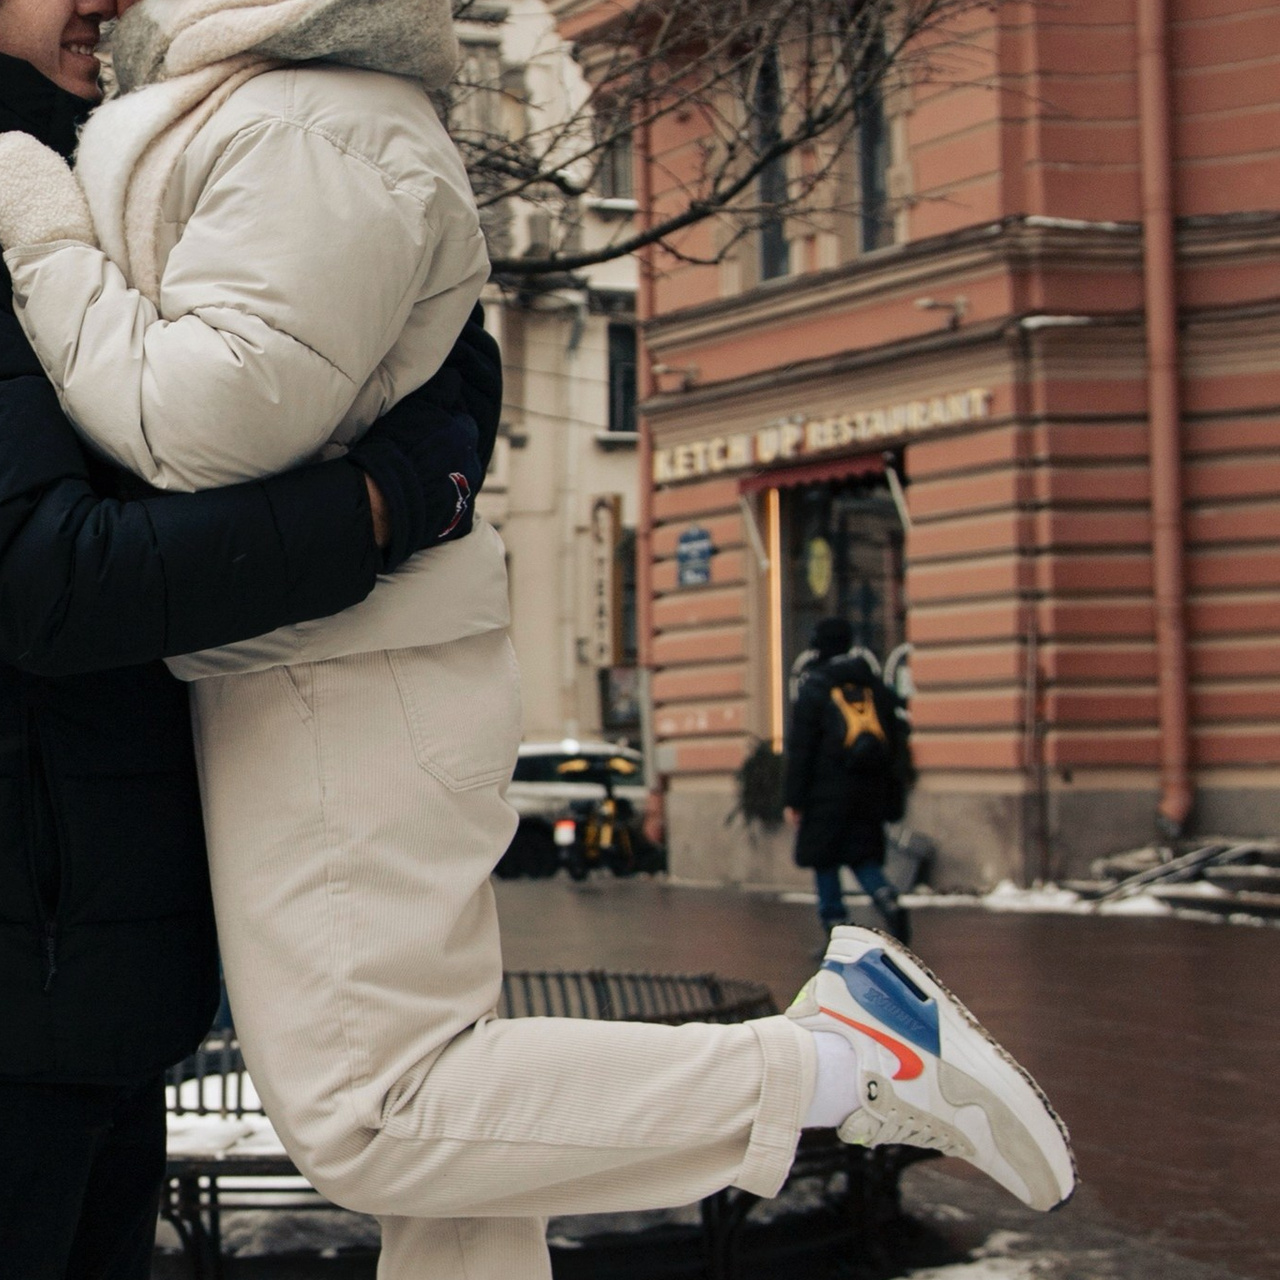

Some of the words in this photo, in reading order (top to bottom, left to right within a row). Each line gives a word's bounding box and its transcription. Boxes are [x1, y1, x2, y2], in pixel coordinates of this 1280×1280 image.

[653, 435, 754, 485] KETCH
[757, 424, 802, 464] UP
[806, 388, 989, 451] RESTAURANT
